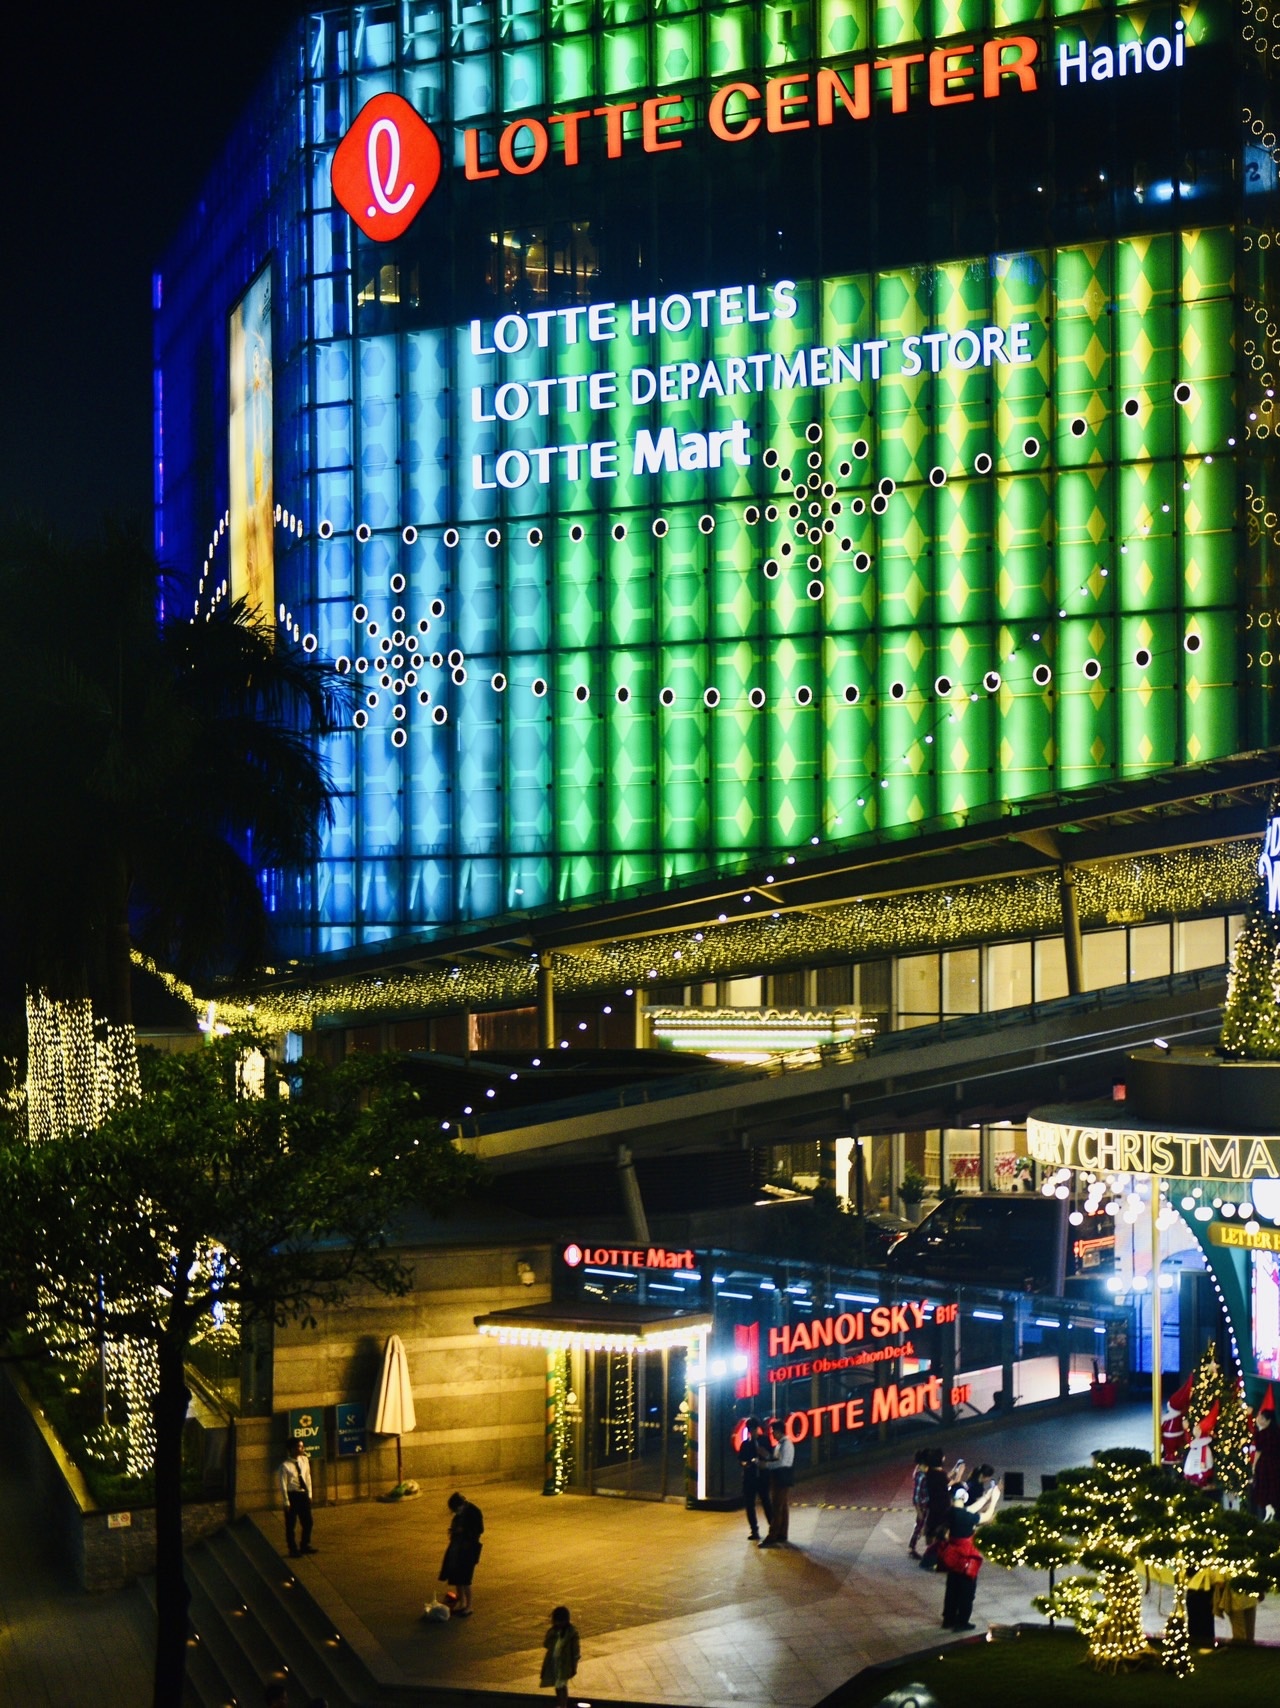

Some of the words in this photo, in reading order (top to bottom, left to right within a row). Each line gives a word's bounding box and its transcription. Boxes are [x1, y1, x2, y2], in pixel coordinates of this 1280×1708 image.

[463, 96, 685, 182] LOTTE
[708, 35, 1040, 143] CENTER
[1058, 20, 1187, 87] Hanoi
[470, 301, 617, 356] LOTTE
[630, 280, 799, 336] HOTELS
[471, 367, 617, 423] LOTTE
[630, 339, 883, 406] DEPARTMENT
[901, 323, 1032, 378] STORE
[471, 433, 618, 491] LOTTE
[632, 418, 752, 476] Mart
[583, 1248, 645, 1267] LOTTE
[646, 1248, 695, 1270] Mart
[1221, 1227, 1272, 1250] LETTER
[769, 1312, 864, 1358] HANOI
[870, 1298, 930, 1338] SKY
[935, 1303, 958, 1325] B1F
[768, 1363, 810, 1384] LOTTE
[872, 1374, 943, 1425] Mart
[293, 1426, 320, 1438] BIDV
